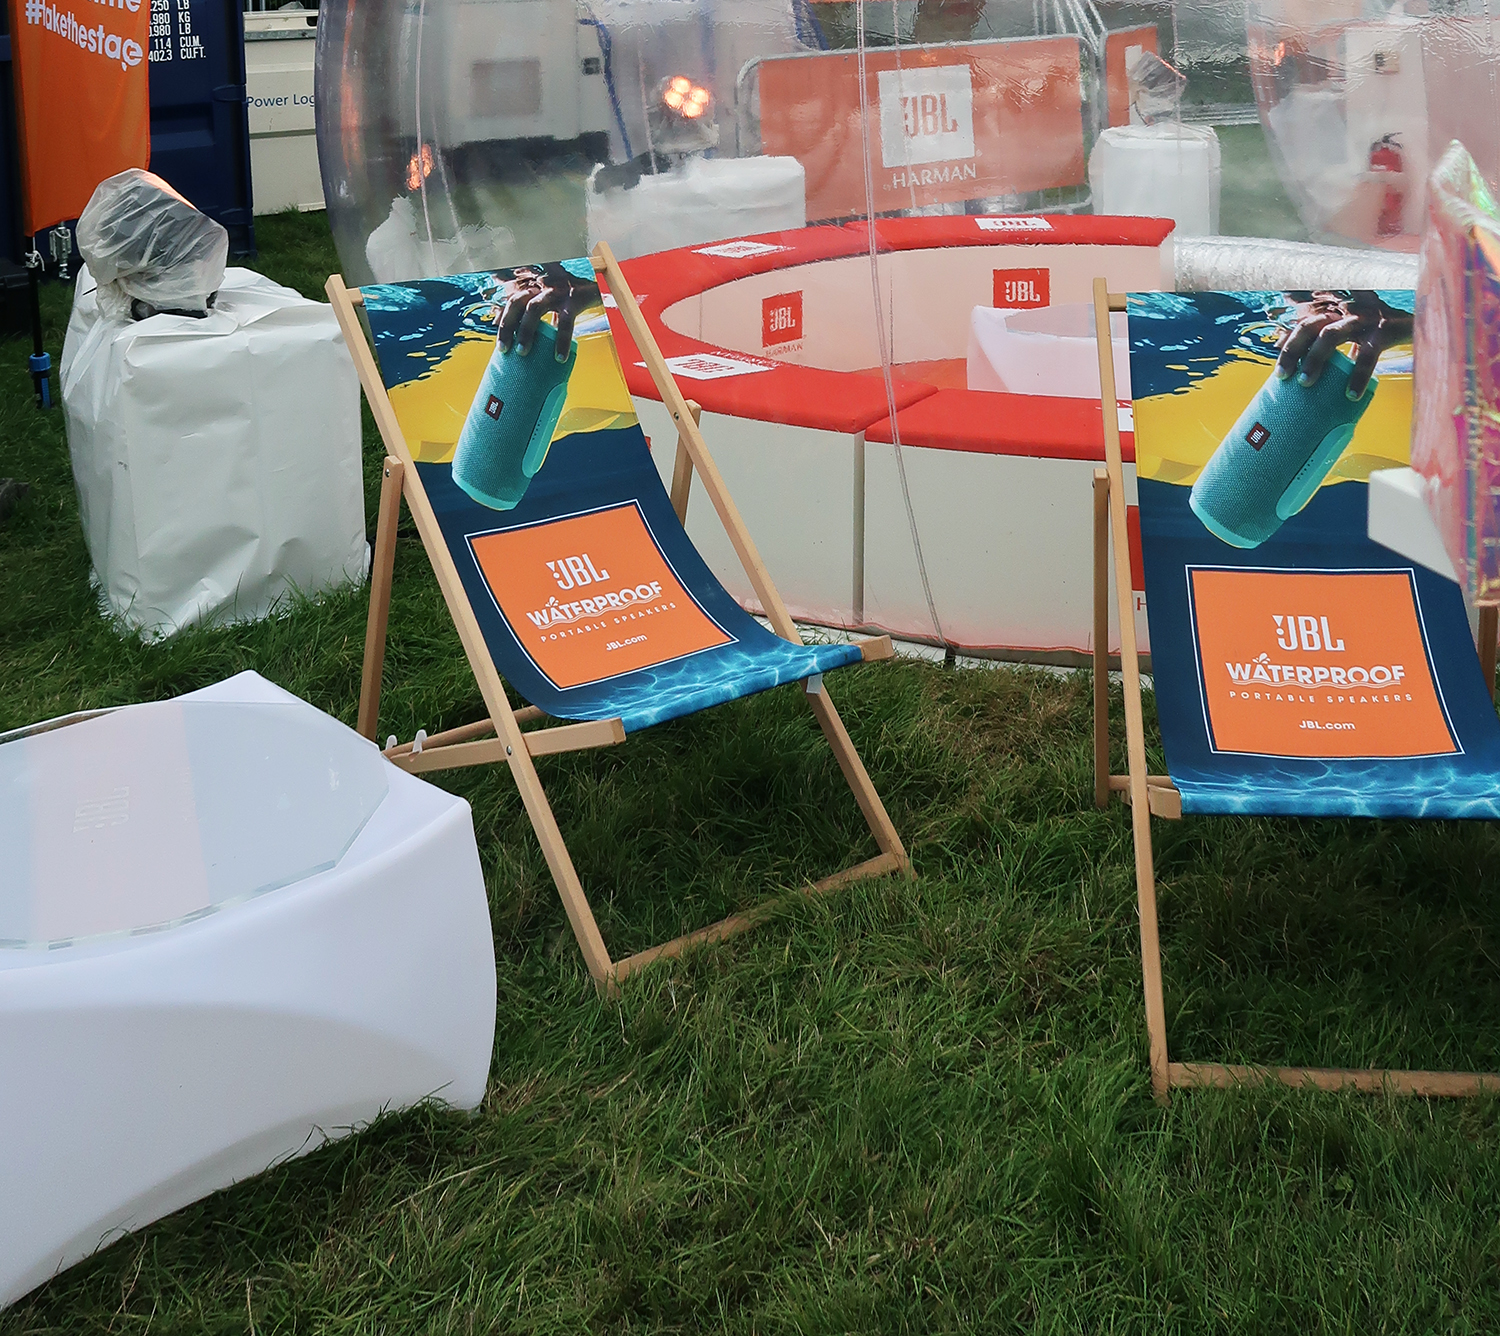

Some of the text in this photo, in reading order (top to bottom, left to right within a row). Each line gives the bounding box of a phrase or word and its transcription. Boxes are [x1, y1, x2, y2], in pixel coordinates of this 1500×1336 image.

[178, 11, 191, 23] KG
[179, 23, 191, 35] LB
[154, 37, 172, 50] 11.4
[247, 96, 288, 107] Power
[902, 93, 959, 138] JBL
[893, 163, 976, 189] HARMAN
[1004, 280, 1041, 302] JBL
[769, 306, 796, 332] JBL
[545, 553, 610, 590] JBL
[526, 580, 663, 627] WATERPROOF
[540, 602, 677, 643] PORTABLE SPEAKERS
[1272, 614, 1346, 651] JBL
[605, 633, 648, 652] JBL.com
[1225, 660, 1406, 685] WATERPROOF
[1229, 690, 1413, 704] PORTABLE SPEAKERS
[1299, 720, 1356, 731] JBL.com
